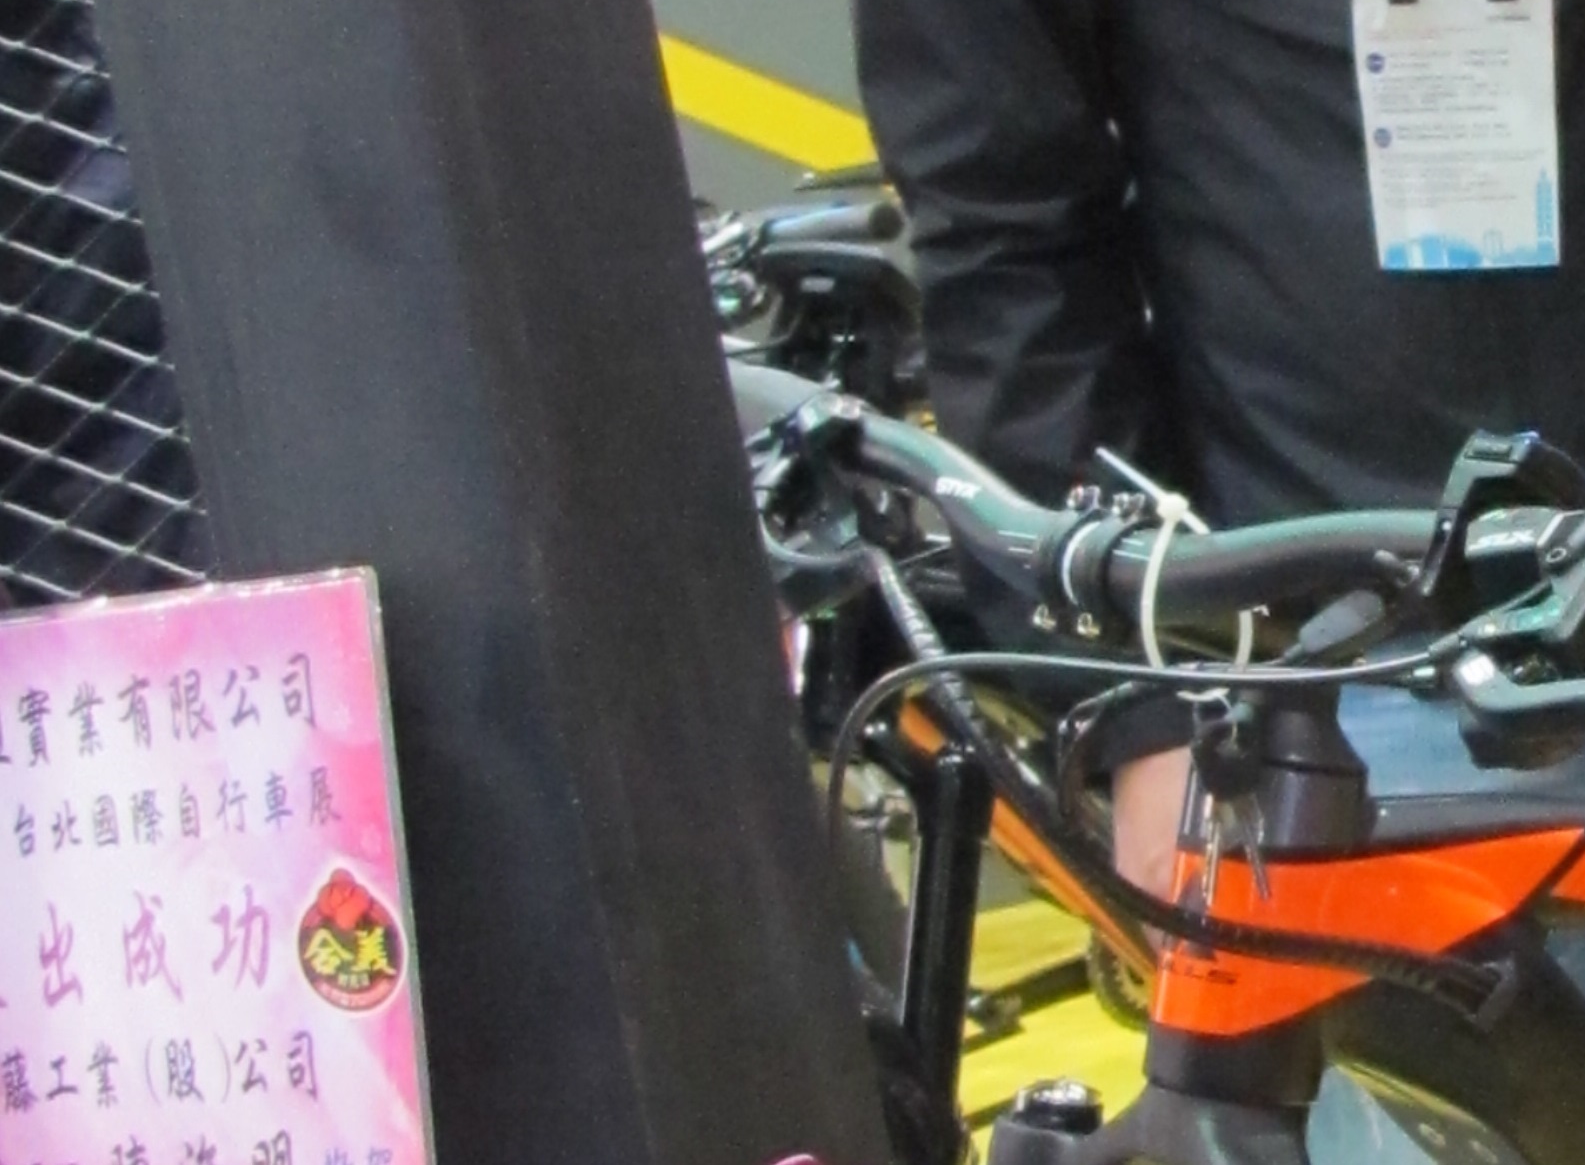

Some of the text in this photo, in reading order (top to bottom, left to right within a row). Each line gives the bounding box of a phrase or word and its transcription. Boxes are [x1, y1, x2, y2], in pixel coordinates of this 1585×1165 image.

[0, 653, 317, 768] 實業有限公司
[0, 882, 271, 1009] 出成功
